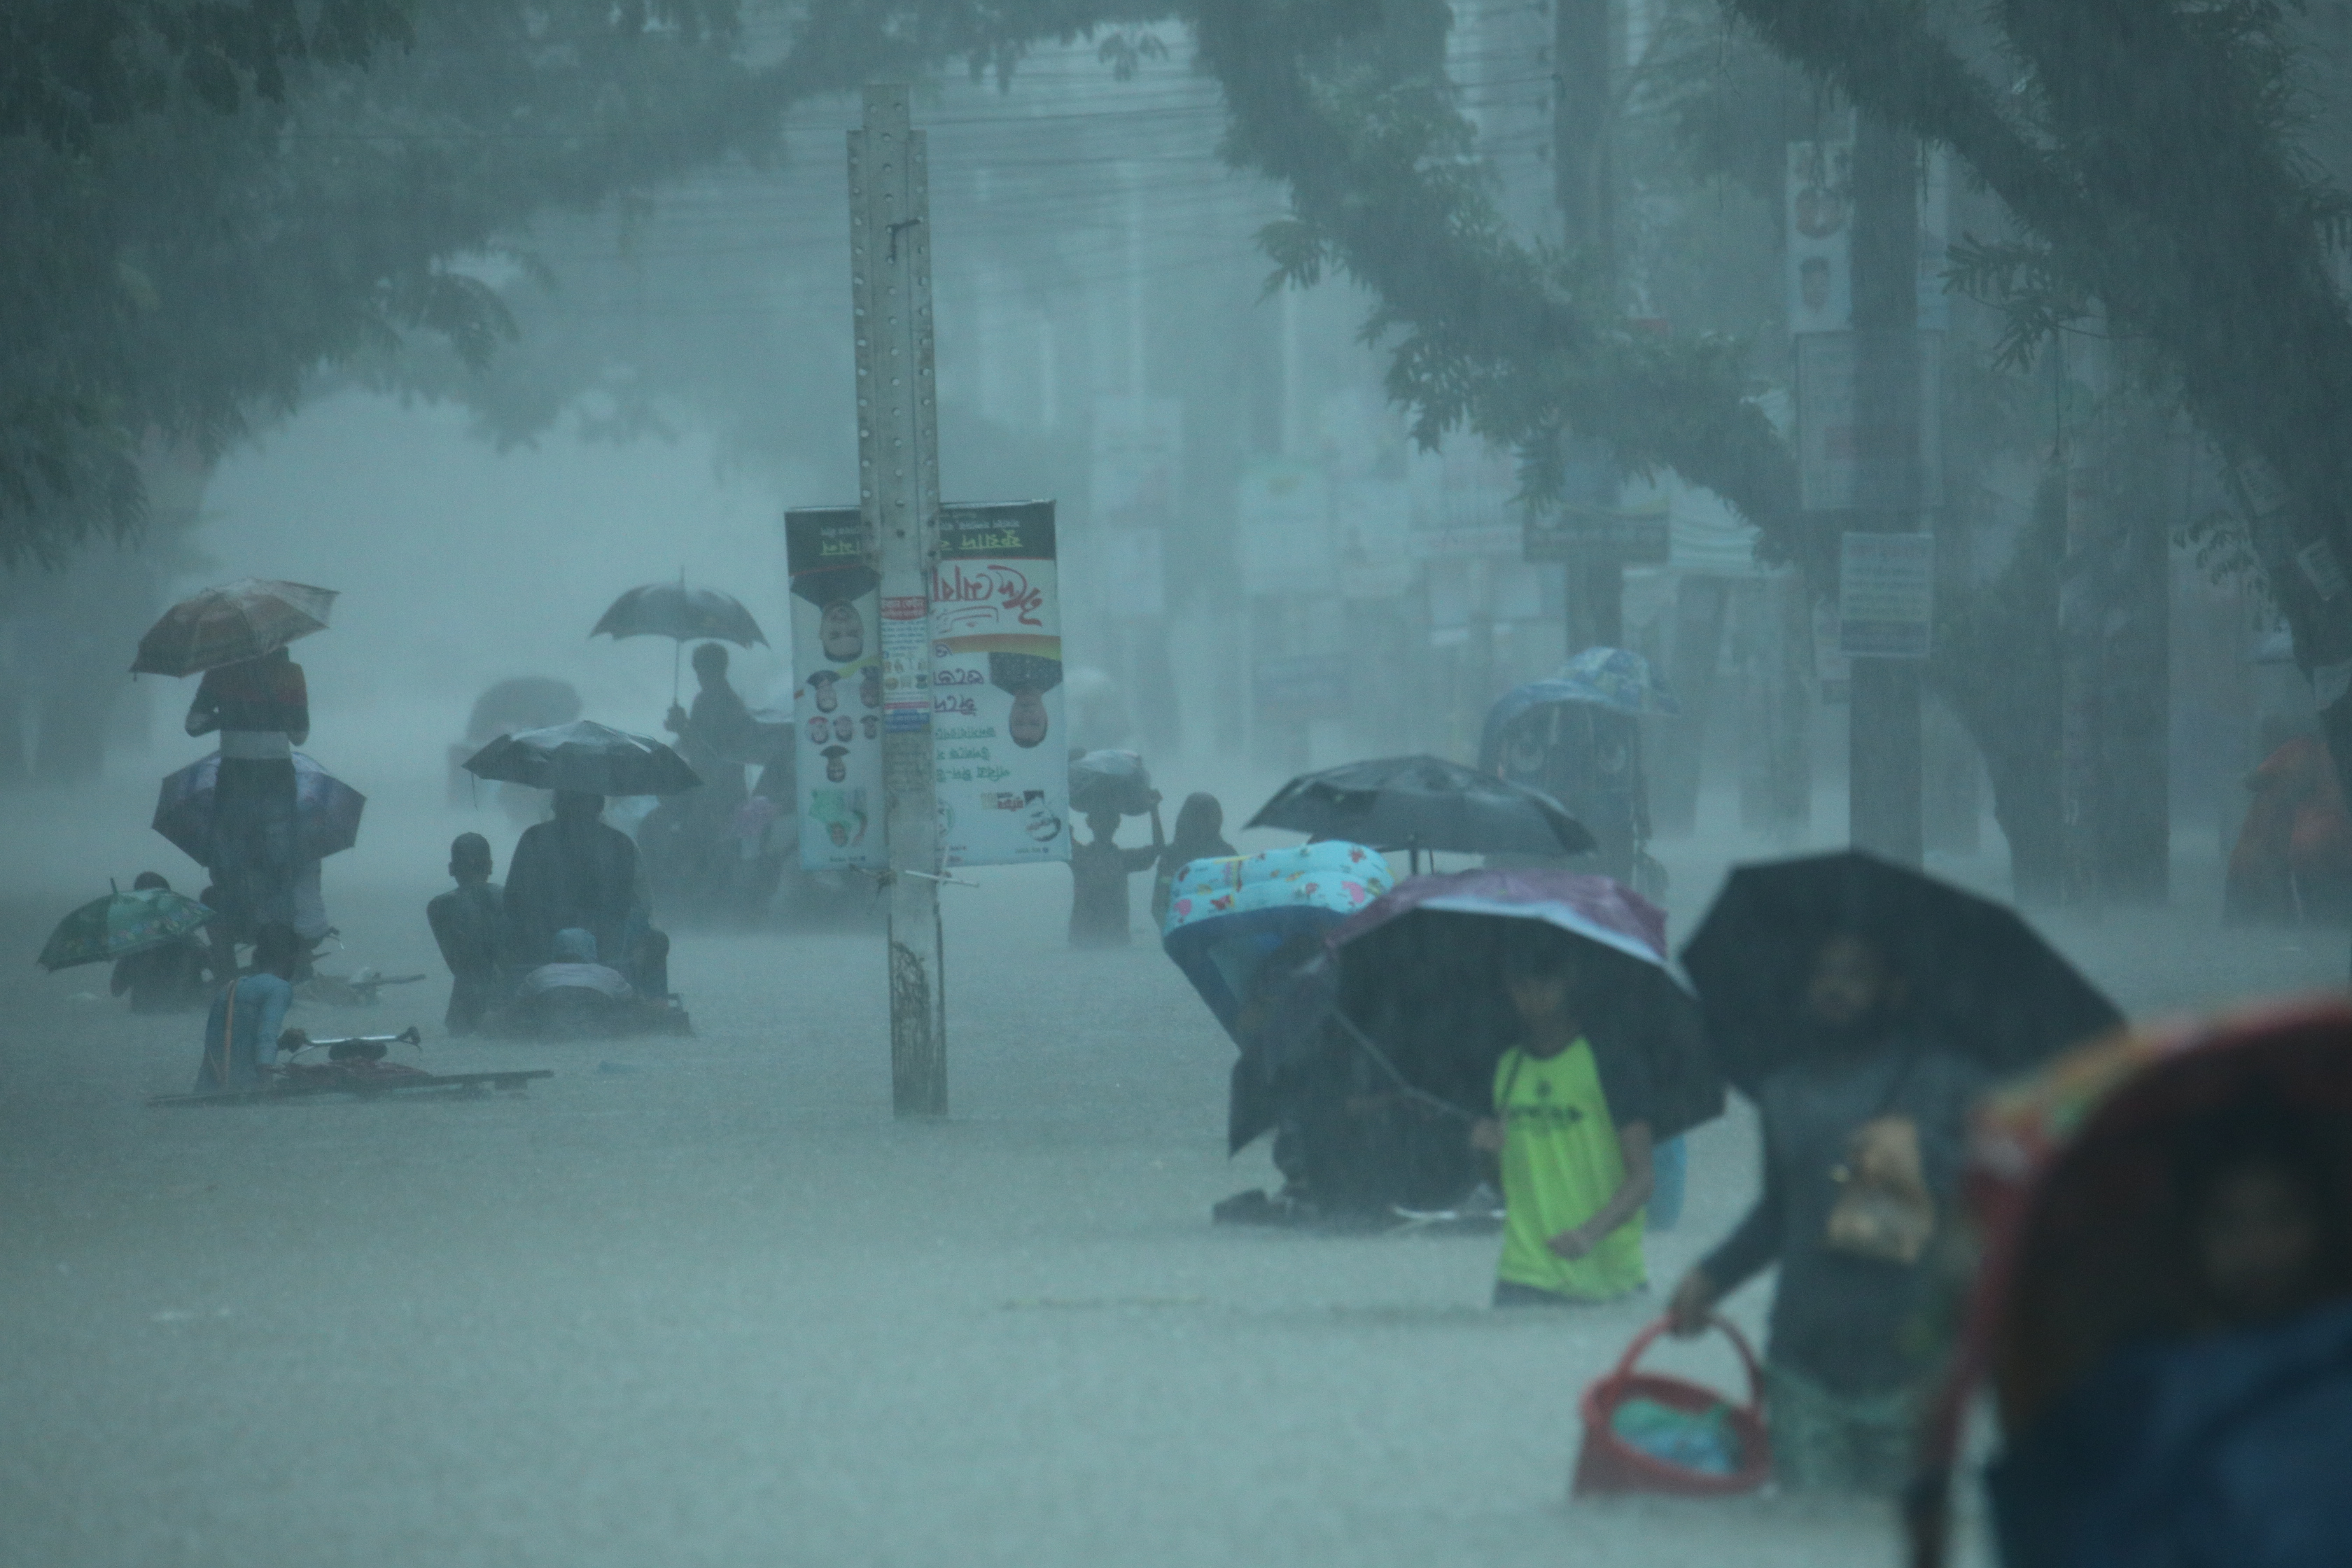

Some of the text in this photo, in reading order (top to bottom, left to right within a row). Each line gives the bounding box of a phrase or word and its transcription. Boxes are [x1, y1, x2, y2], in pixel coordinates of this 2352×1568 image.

[932, 565, 993, 602] মোবা
[934, 643, 953, 659] ও
[933, 694, 978, 717] ঈদে
[936, 767, 972, 783] ঈদ-উ
